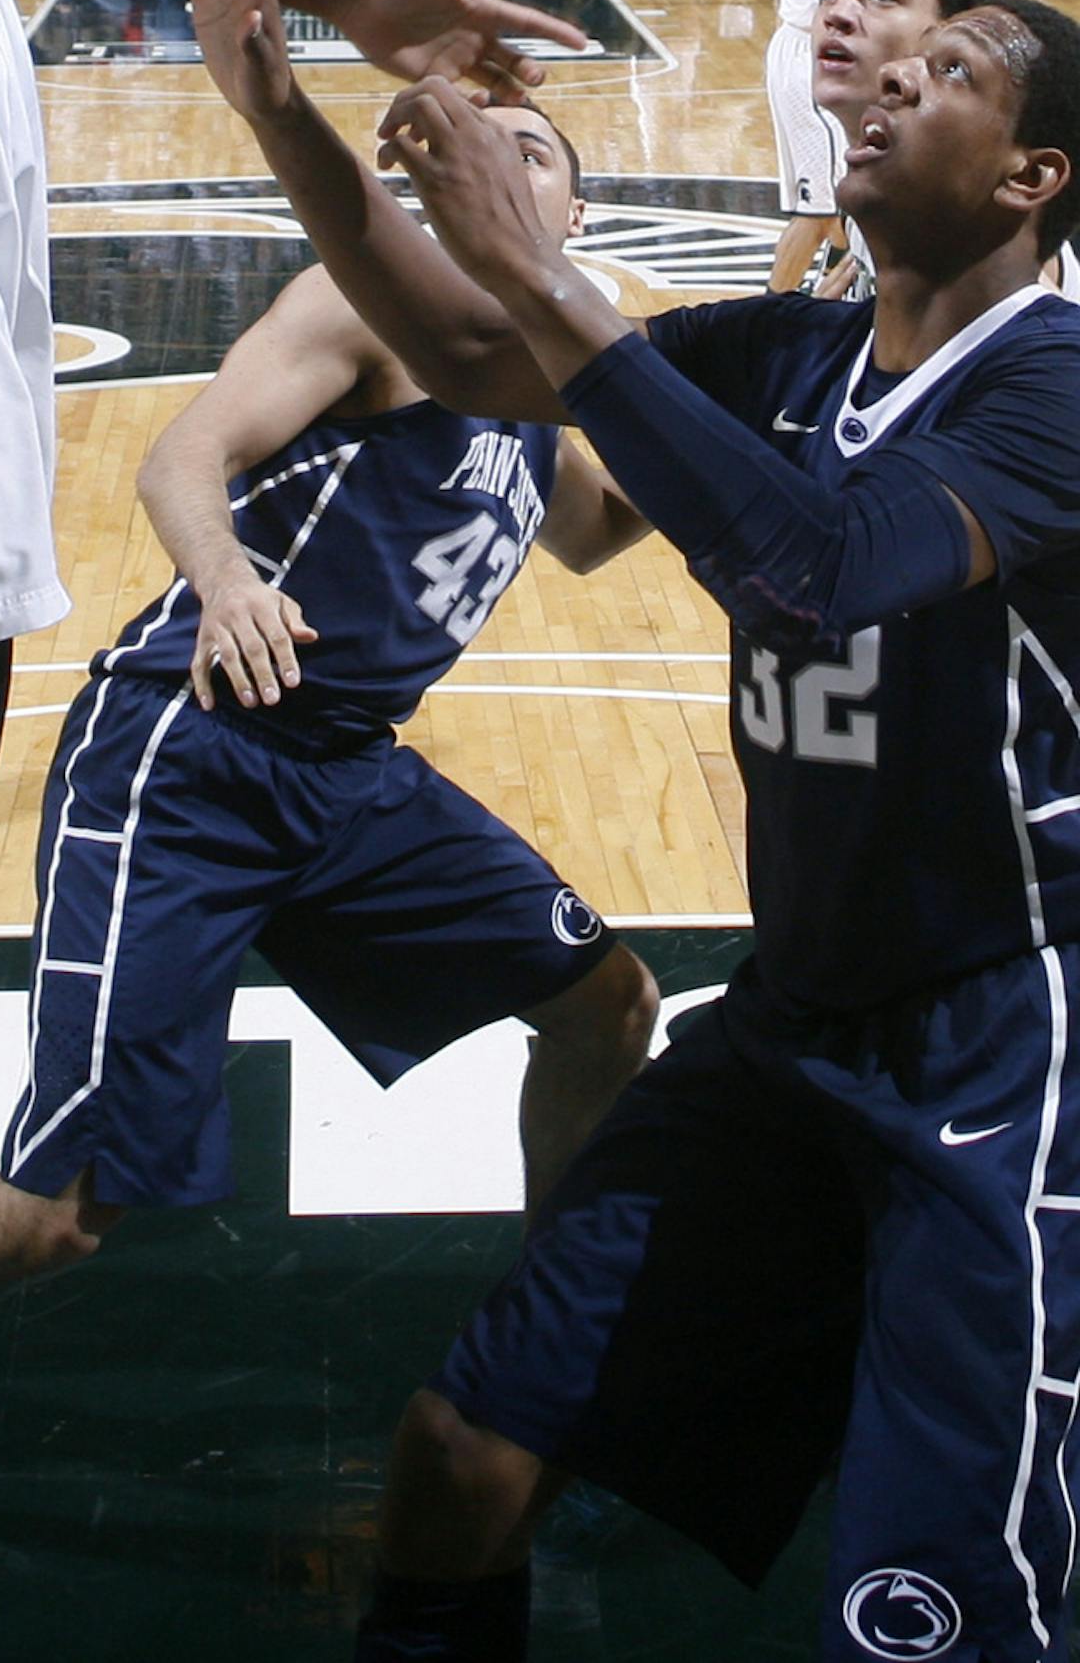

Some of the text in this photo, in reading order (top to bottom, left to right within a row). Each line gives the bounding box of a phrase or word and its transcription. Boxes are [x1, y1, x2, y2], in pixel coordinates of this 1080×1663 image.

[438, 431, 522, 498] PENN
[411, 510, 520, 646] 43
[739, 623, 882, 769] 32
